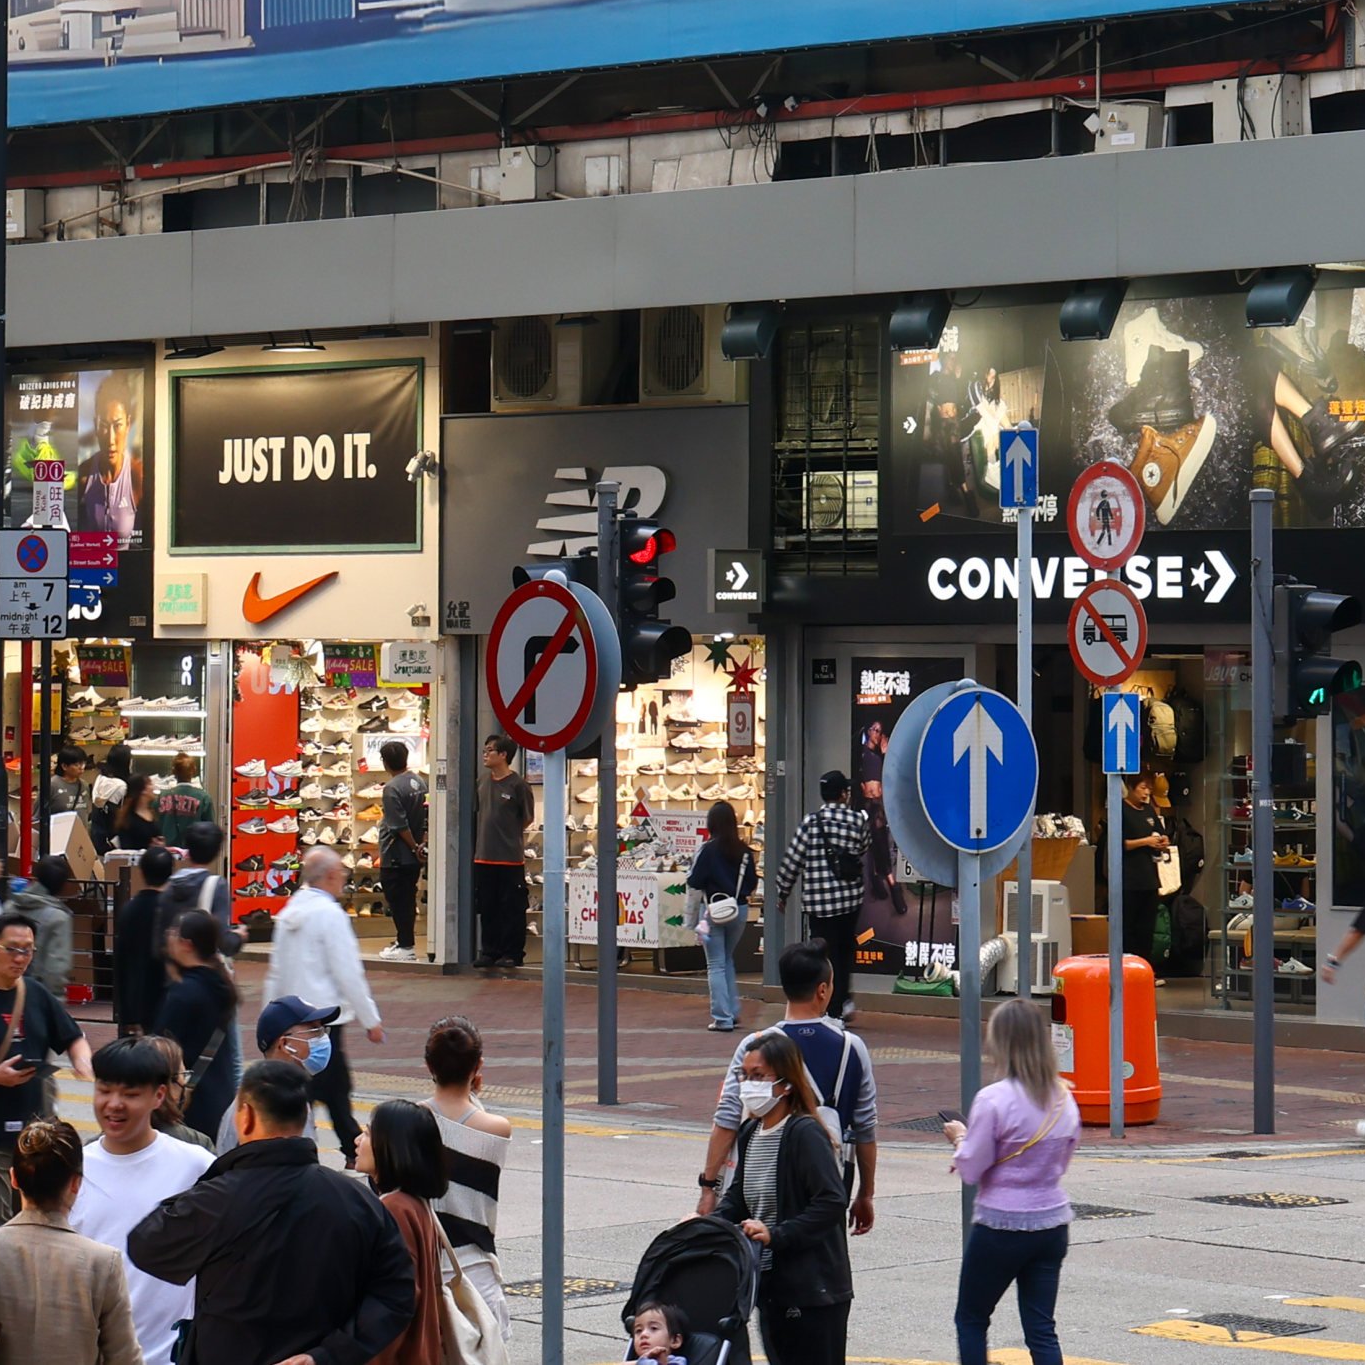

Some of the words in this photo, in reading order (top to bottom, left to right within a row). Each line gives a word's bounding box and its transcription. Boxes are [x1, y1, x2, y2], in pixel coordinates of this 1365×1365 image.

[219, 436, 285, 484] JUST
[292, 436, 335, 481] DO
[343, 432, 378, 479] IT.
[49, 486, 64, 522] 旺角
[927, 557, 1184, 600] CONVESE
[9, 590, 31, 602] 上午
[43, 583, 55, 602] 7
[716, 591, 758, 601] CONVERSE
[0, 612, 38, 622] midnight
[42, 615, 62, 634] 12
[8, 622, 31, 635] 午夜
[102, 661, 125, 674] SALE
[349, 659, 374, 671] SALE
